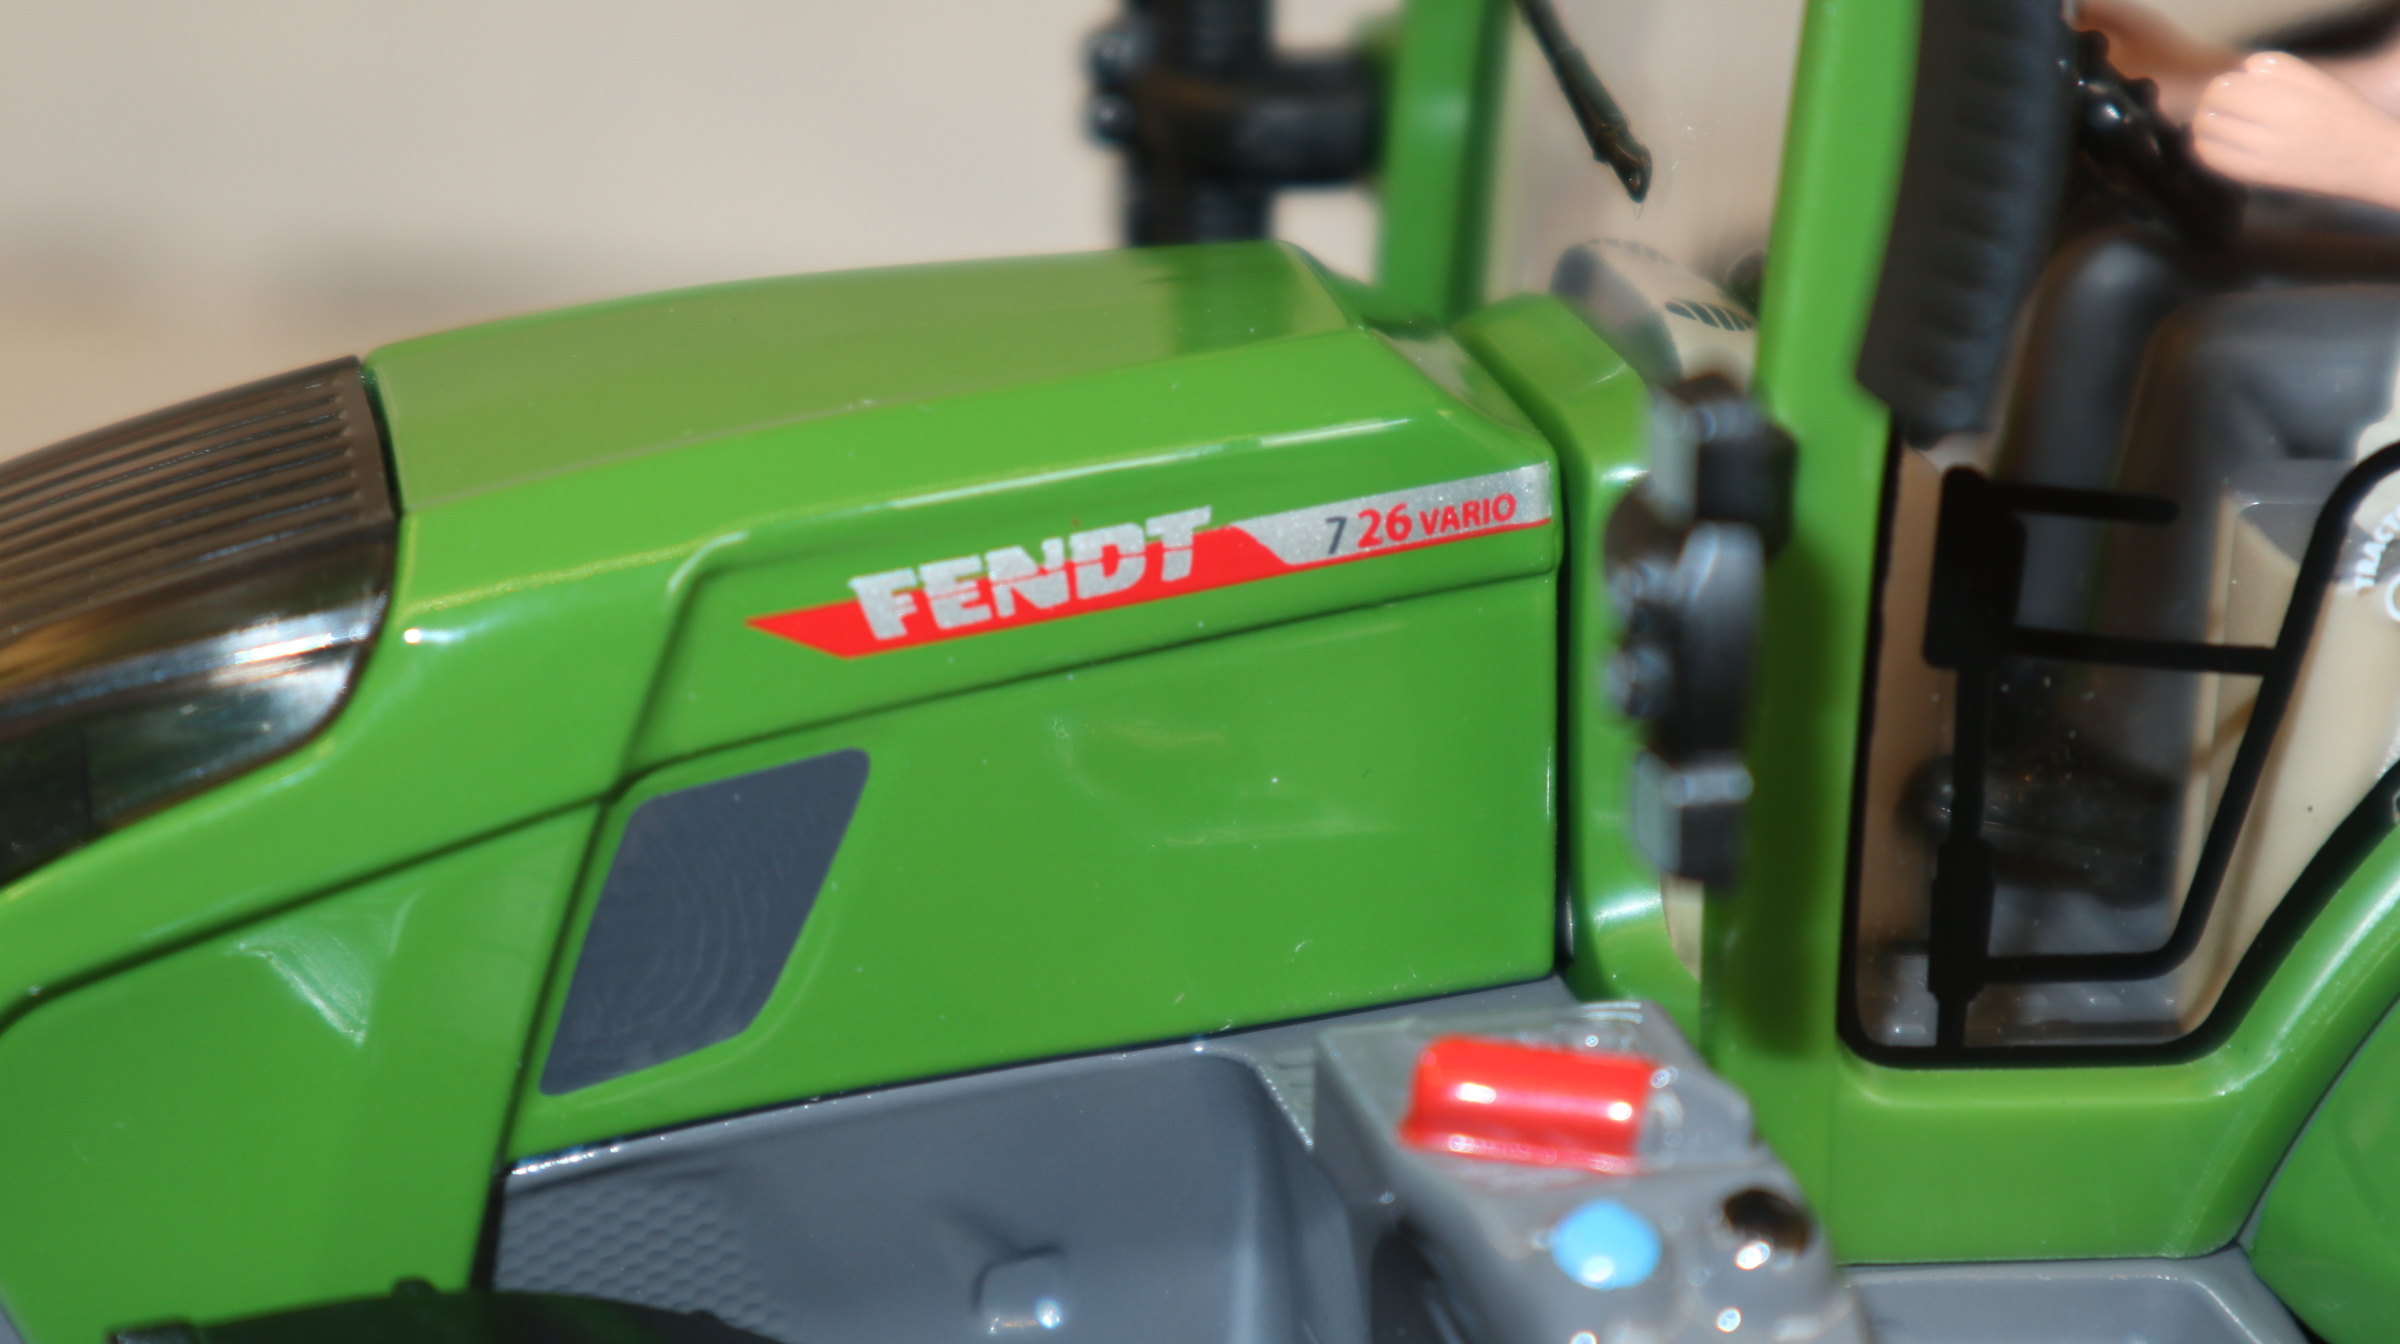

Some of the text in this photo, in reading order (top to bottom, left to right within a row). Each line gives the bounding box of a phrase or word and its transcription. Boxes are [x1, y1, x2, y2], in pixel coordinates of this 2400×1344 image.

[1419, 492, 1517, 536] VARIO
[2354, 502, 2400, 590] TRACT
[848, 505, 1213, 641] FENDT
